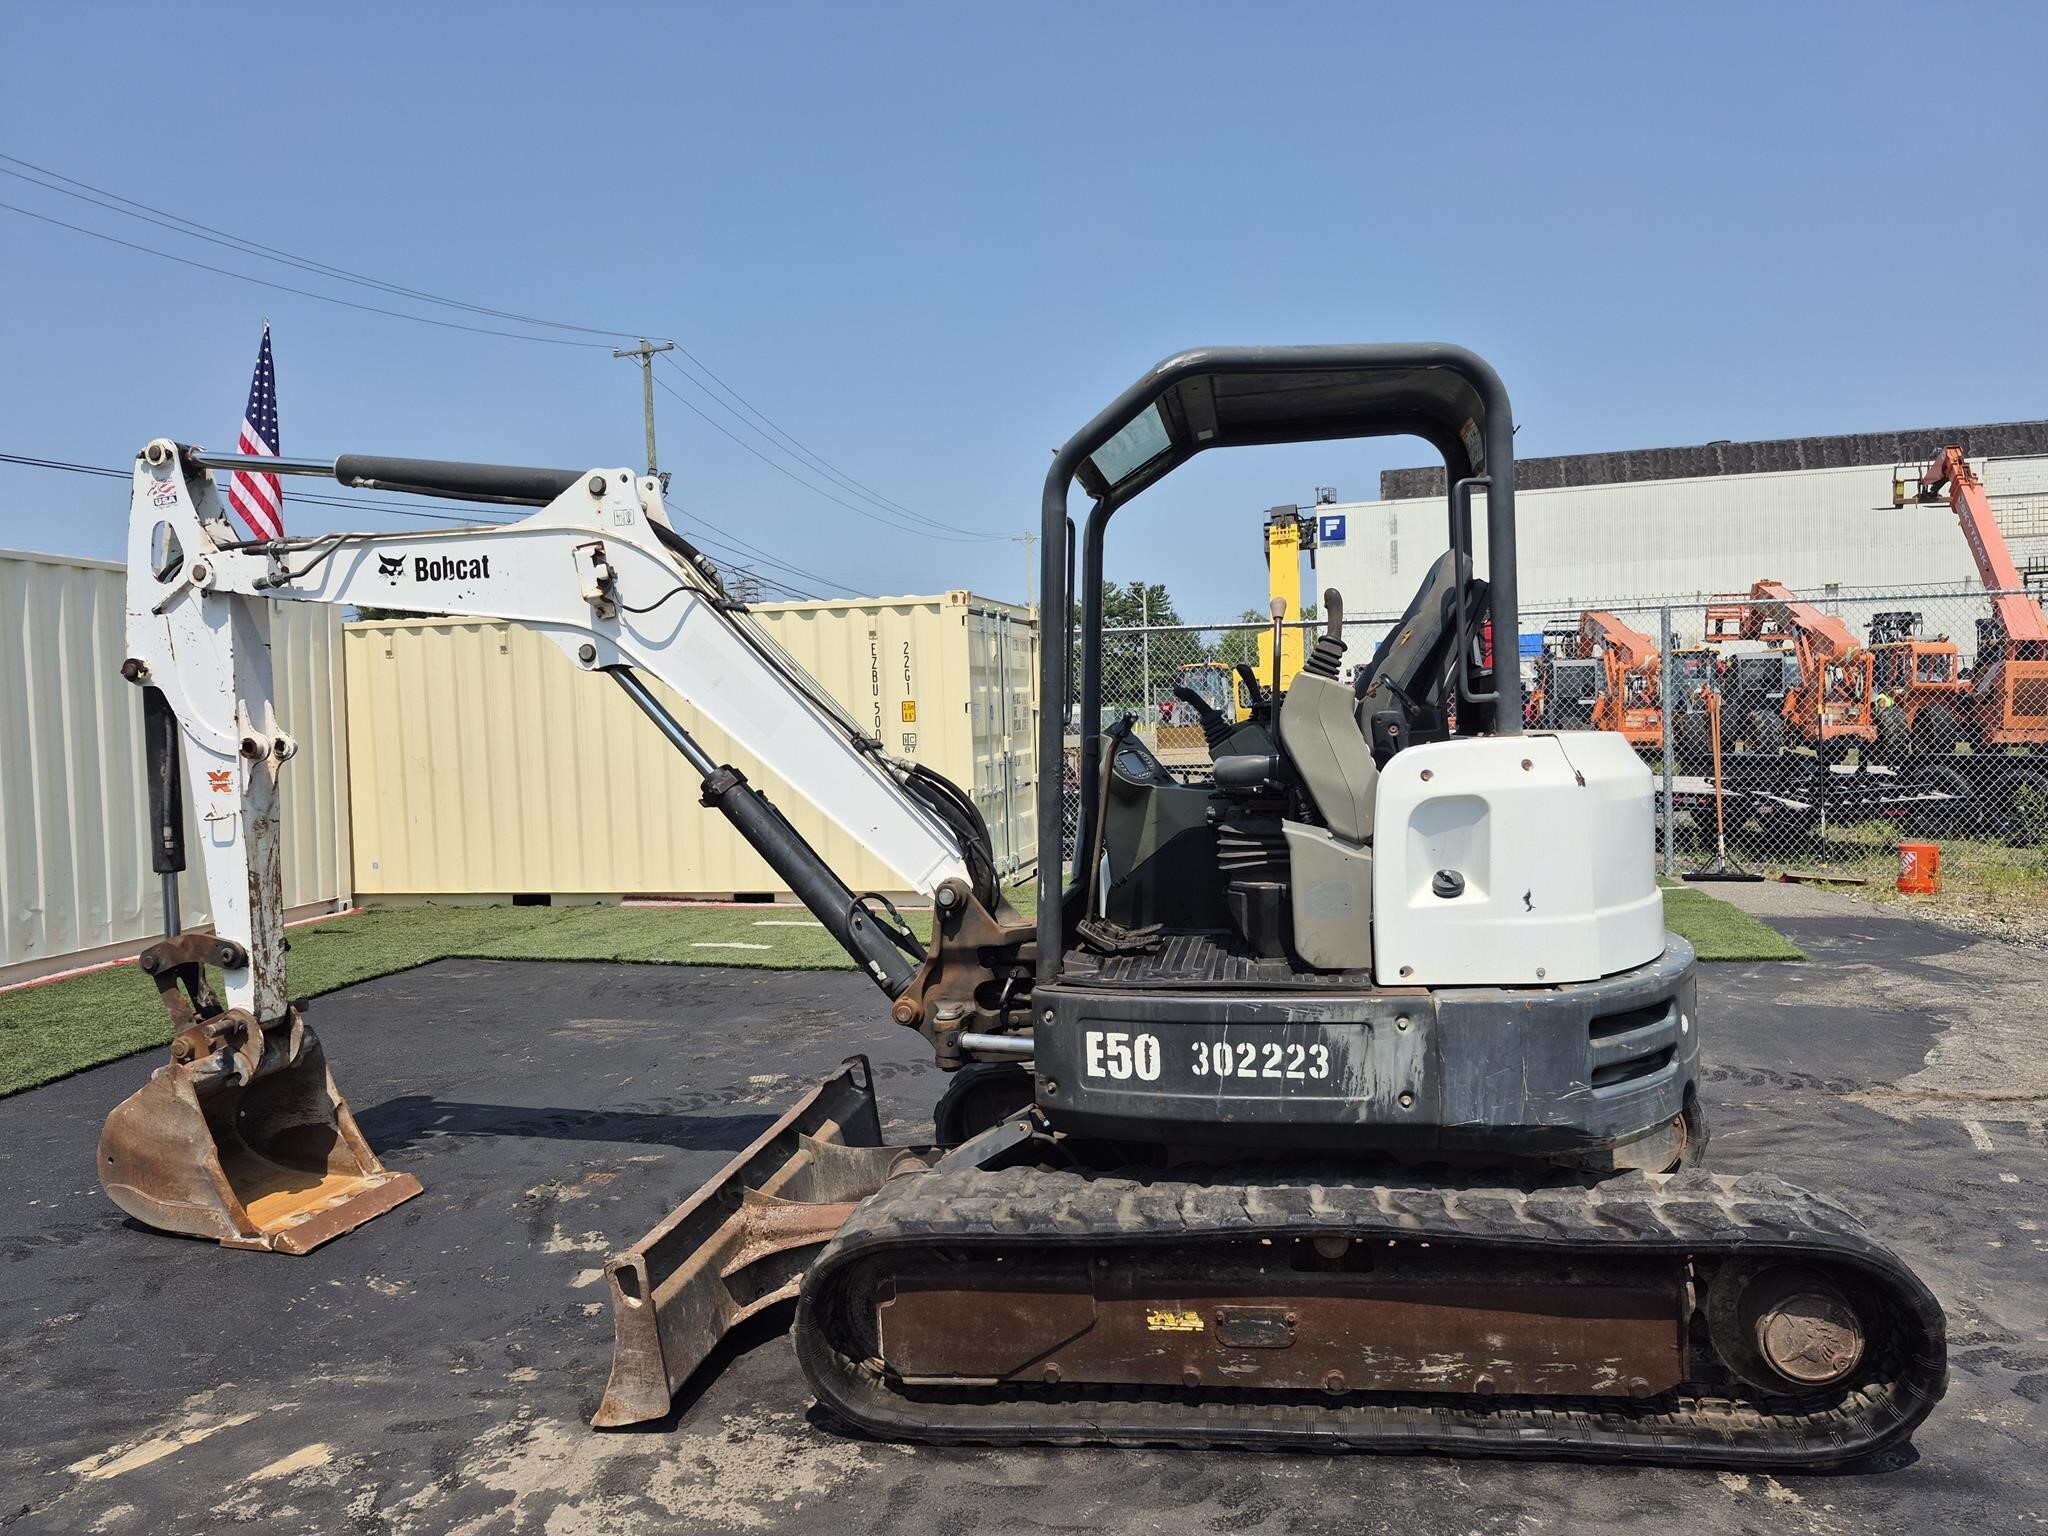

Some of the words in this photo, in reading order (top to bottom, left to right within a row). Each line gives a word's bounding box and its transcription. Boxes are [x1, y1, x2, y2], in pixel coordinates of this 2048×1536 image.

[155, 496, 177, 506] USA
[414, 555, 490, 582] Bobcat
[871, 642, 879, 696] EZBU
[903, 641, 911, 695] 22G1
[1086, 1031, 1161, 1081] E50
[1191, 1041, 1329, 1080] 302223
